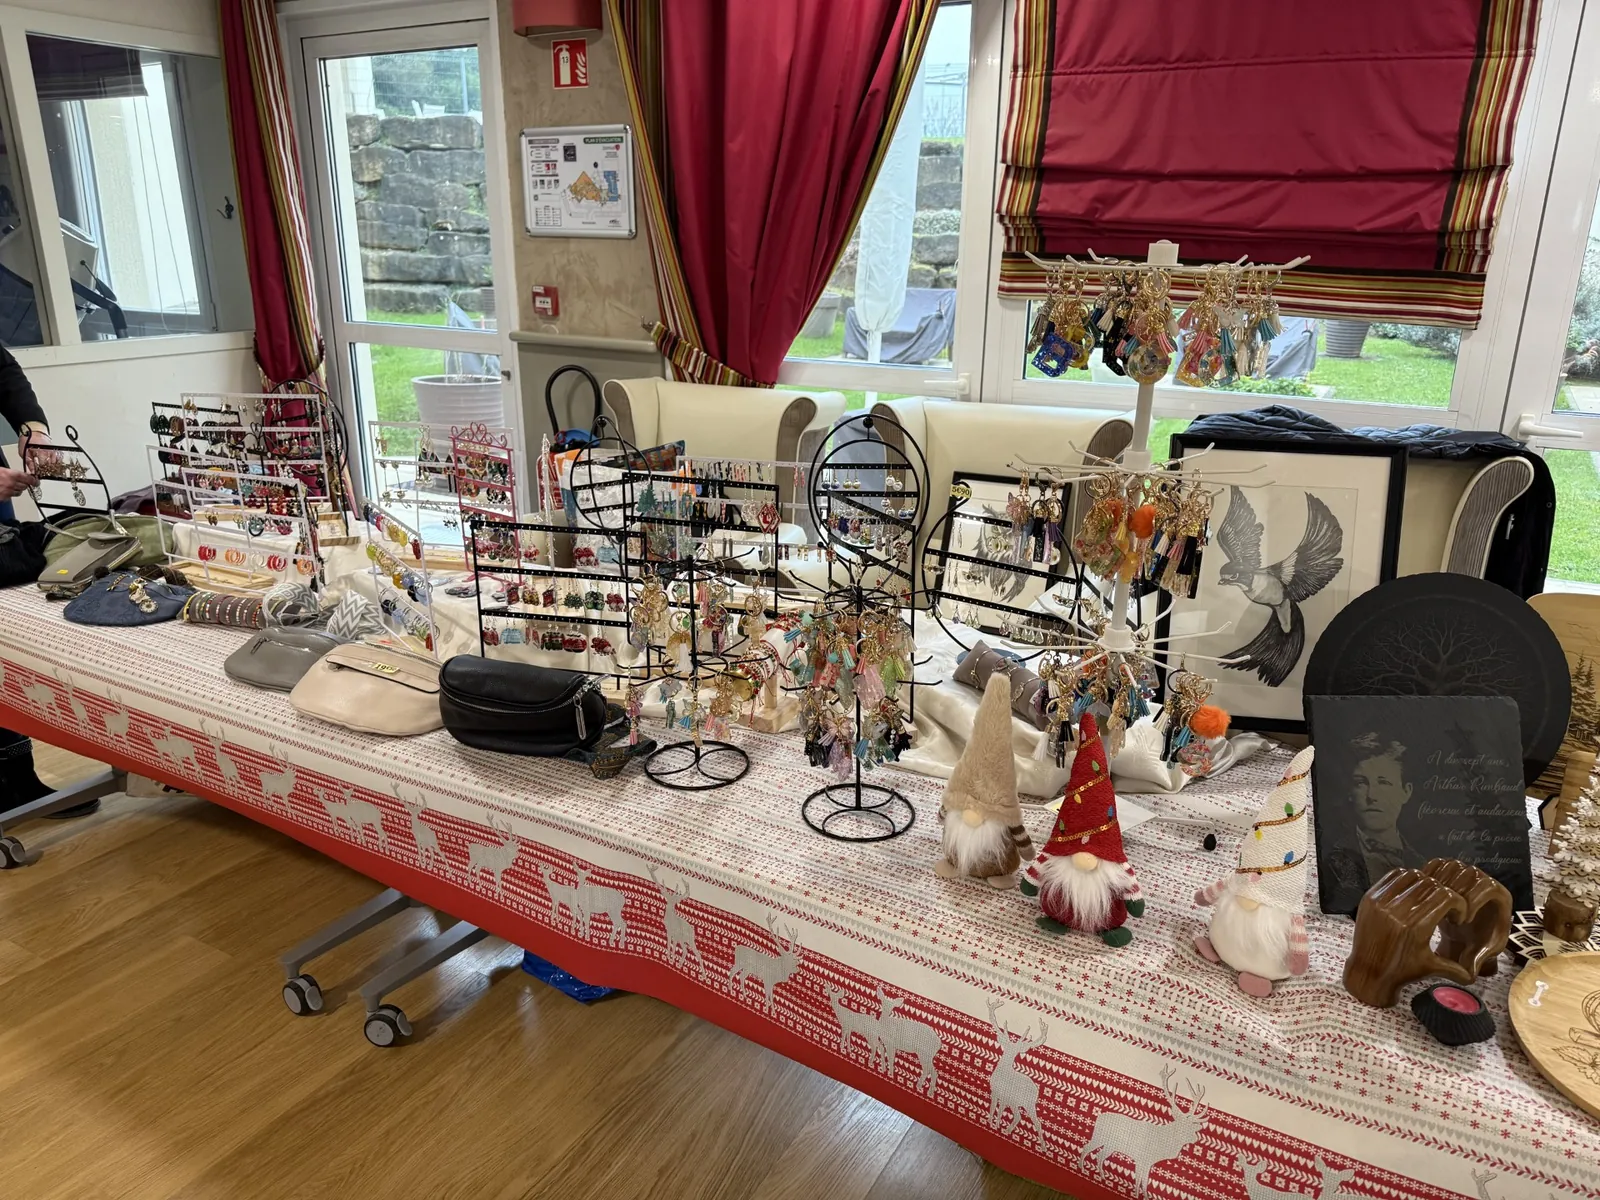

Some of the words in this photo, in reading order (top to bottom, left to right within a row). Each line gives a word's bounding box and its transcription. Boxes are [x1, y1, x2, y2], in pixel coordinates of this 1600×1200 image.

[1423, 774, 1467, 792] Arthur
[1470, 774, 1524, 795] Rimbaud
[1464, 803, 1481, 816] et
